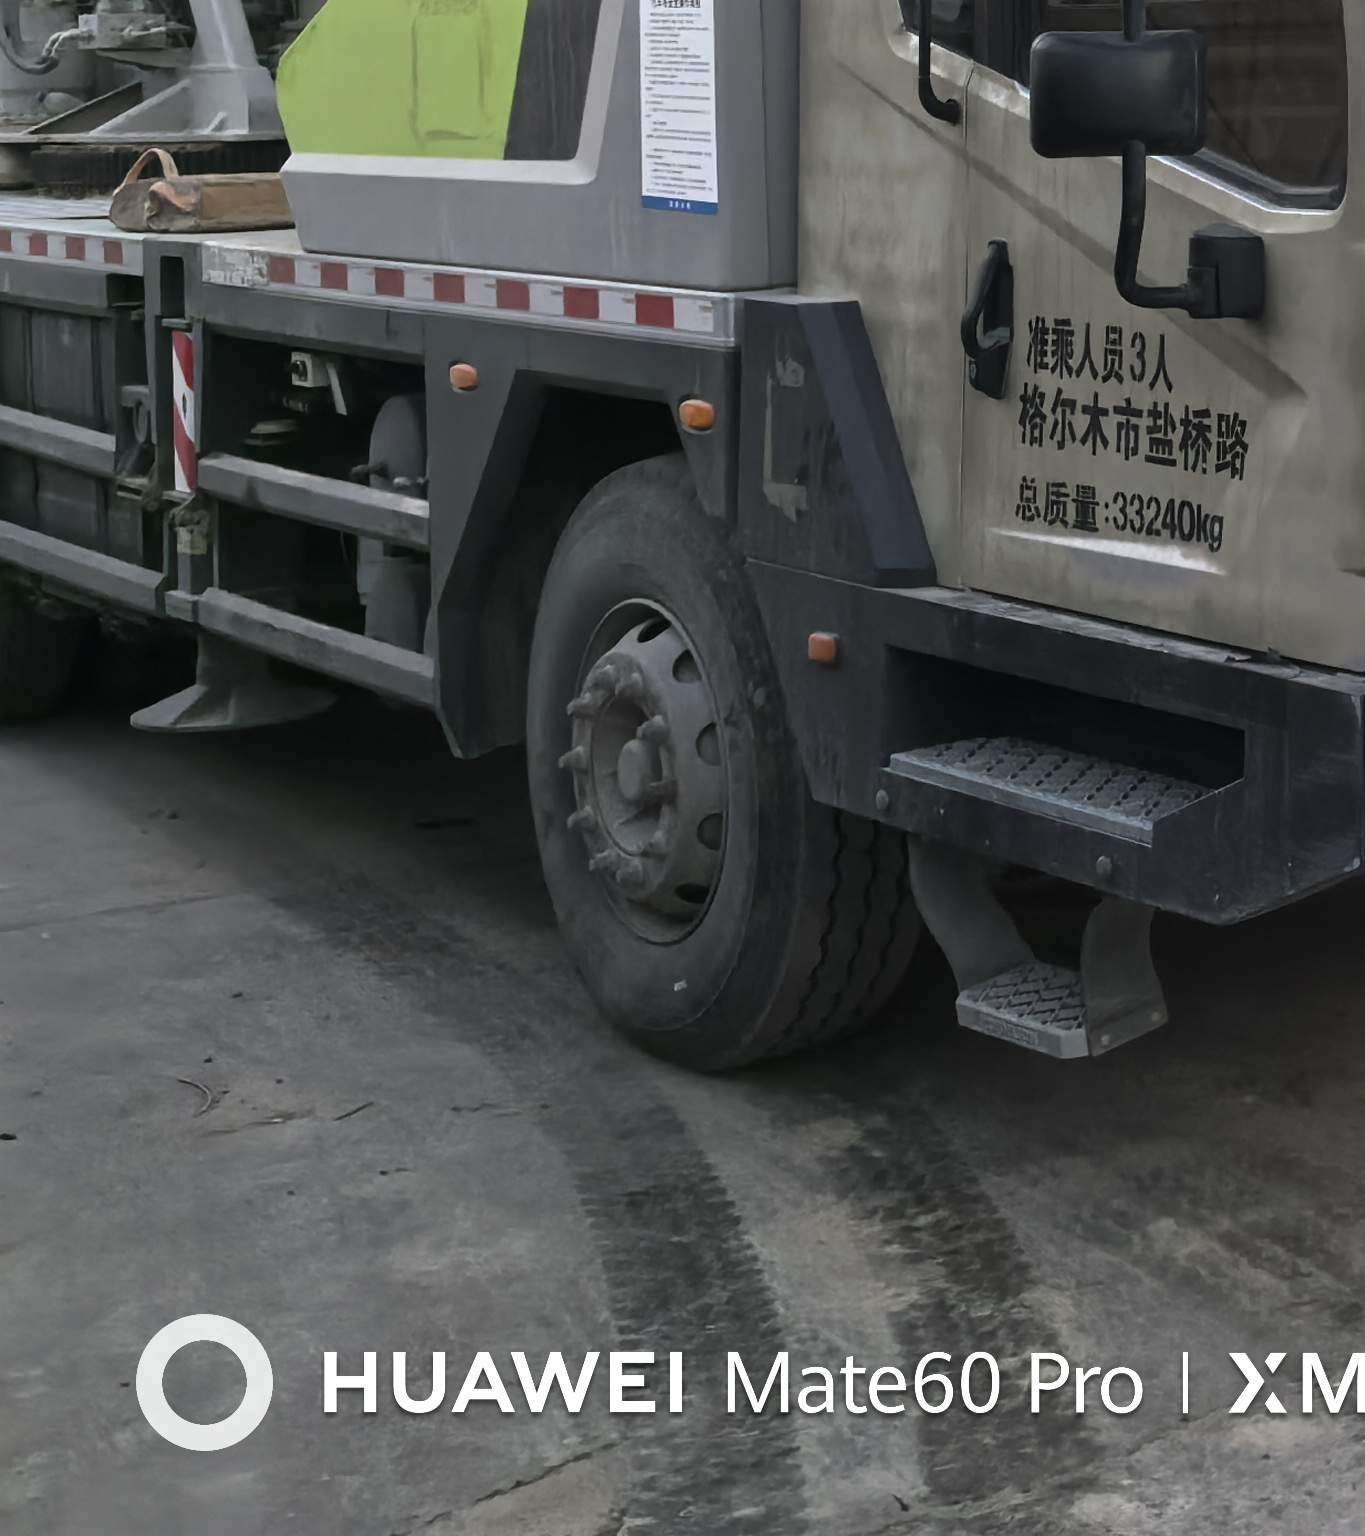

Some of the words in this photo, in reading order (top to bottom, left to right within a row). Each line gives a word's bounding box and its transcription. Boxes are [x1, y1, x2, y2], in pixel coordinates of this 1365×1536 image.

[1026, 315, 1174, 394] 准乘人员3人
[1018, 383, 1249, 481] 格尔木市盐桥路
